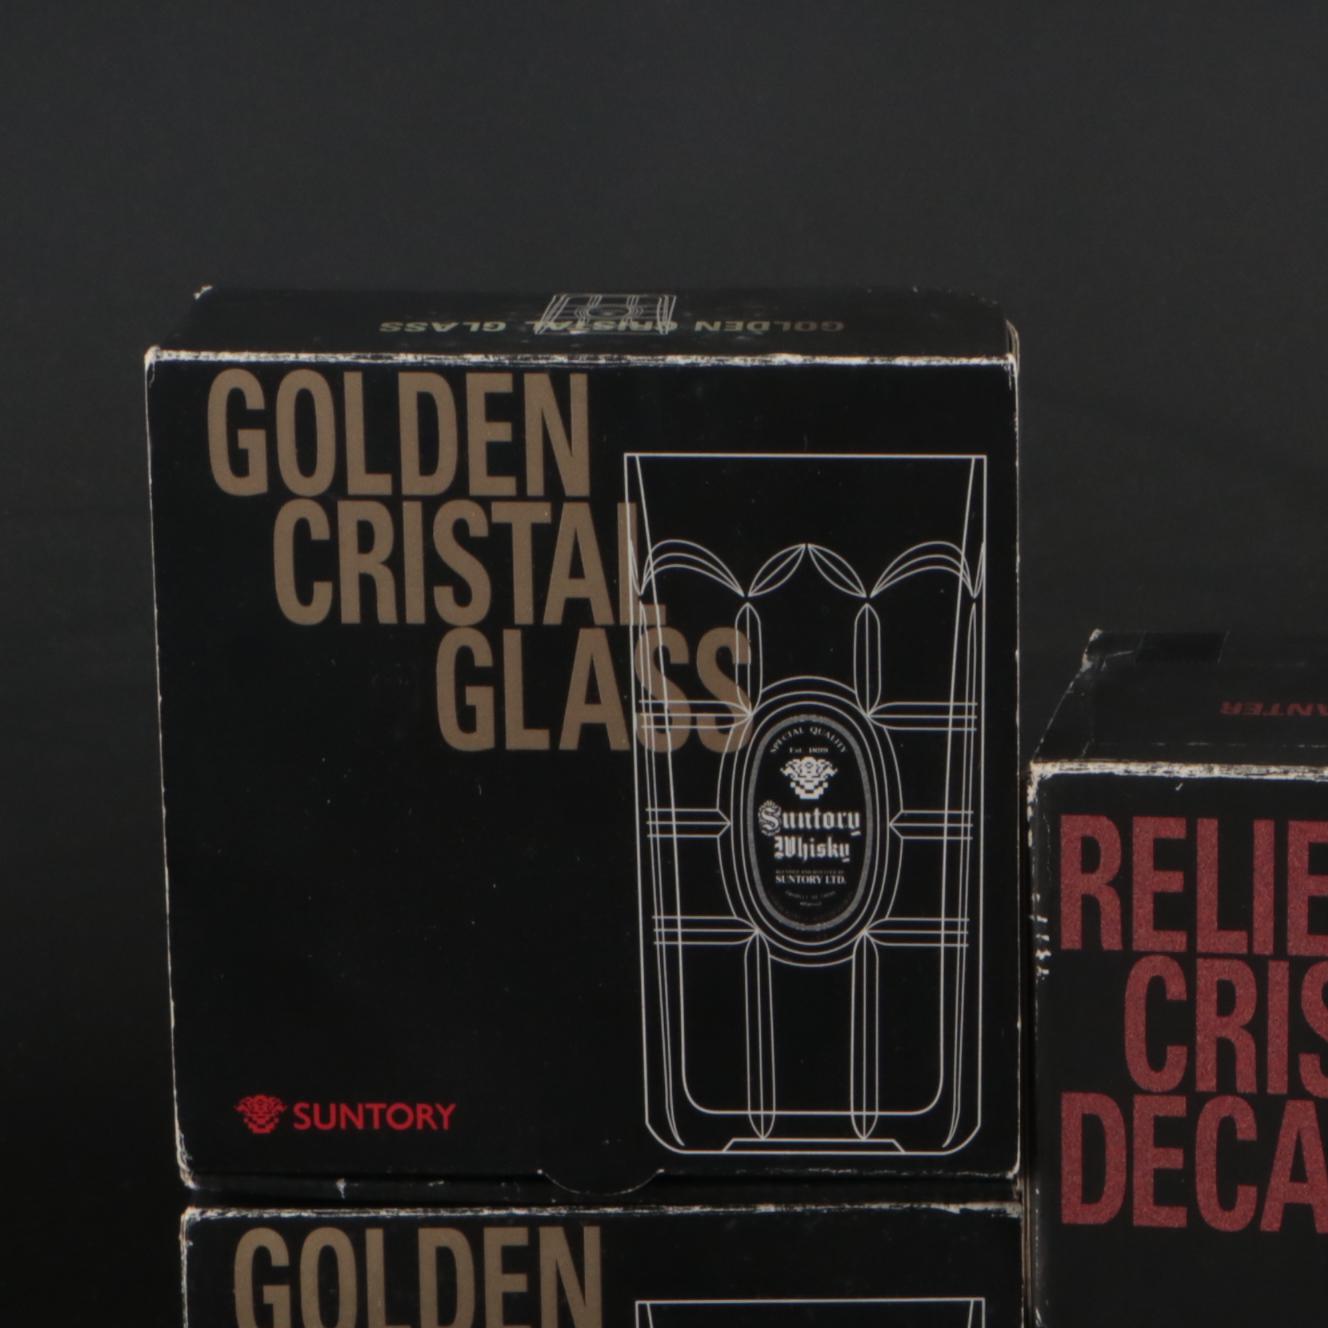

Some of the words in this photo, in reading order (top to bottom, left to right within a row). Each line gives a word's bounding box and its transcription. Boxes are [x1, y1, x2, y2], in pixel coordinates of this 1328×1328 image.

[379, 320, 506, 333] GLASS
[525, 320, 678, 335] CRISTAL
[694, 320, 846, 333] GOLDEN
[207, 368, 592, 497] GOLDEN
[272, 498, 667, 626] CRISTAL
[435, 627, 753, 753] GLASS
[758, 800, 862, 837] Suntory
[774, 835, 850, 863] Whisky
[775, 875, 822, 885] SUNTORY
[292, 1102, 457, 1131] SUNTORY
